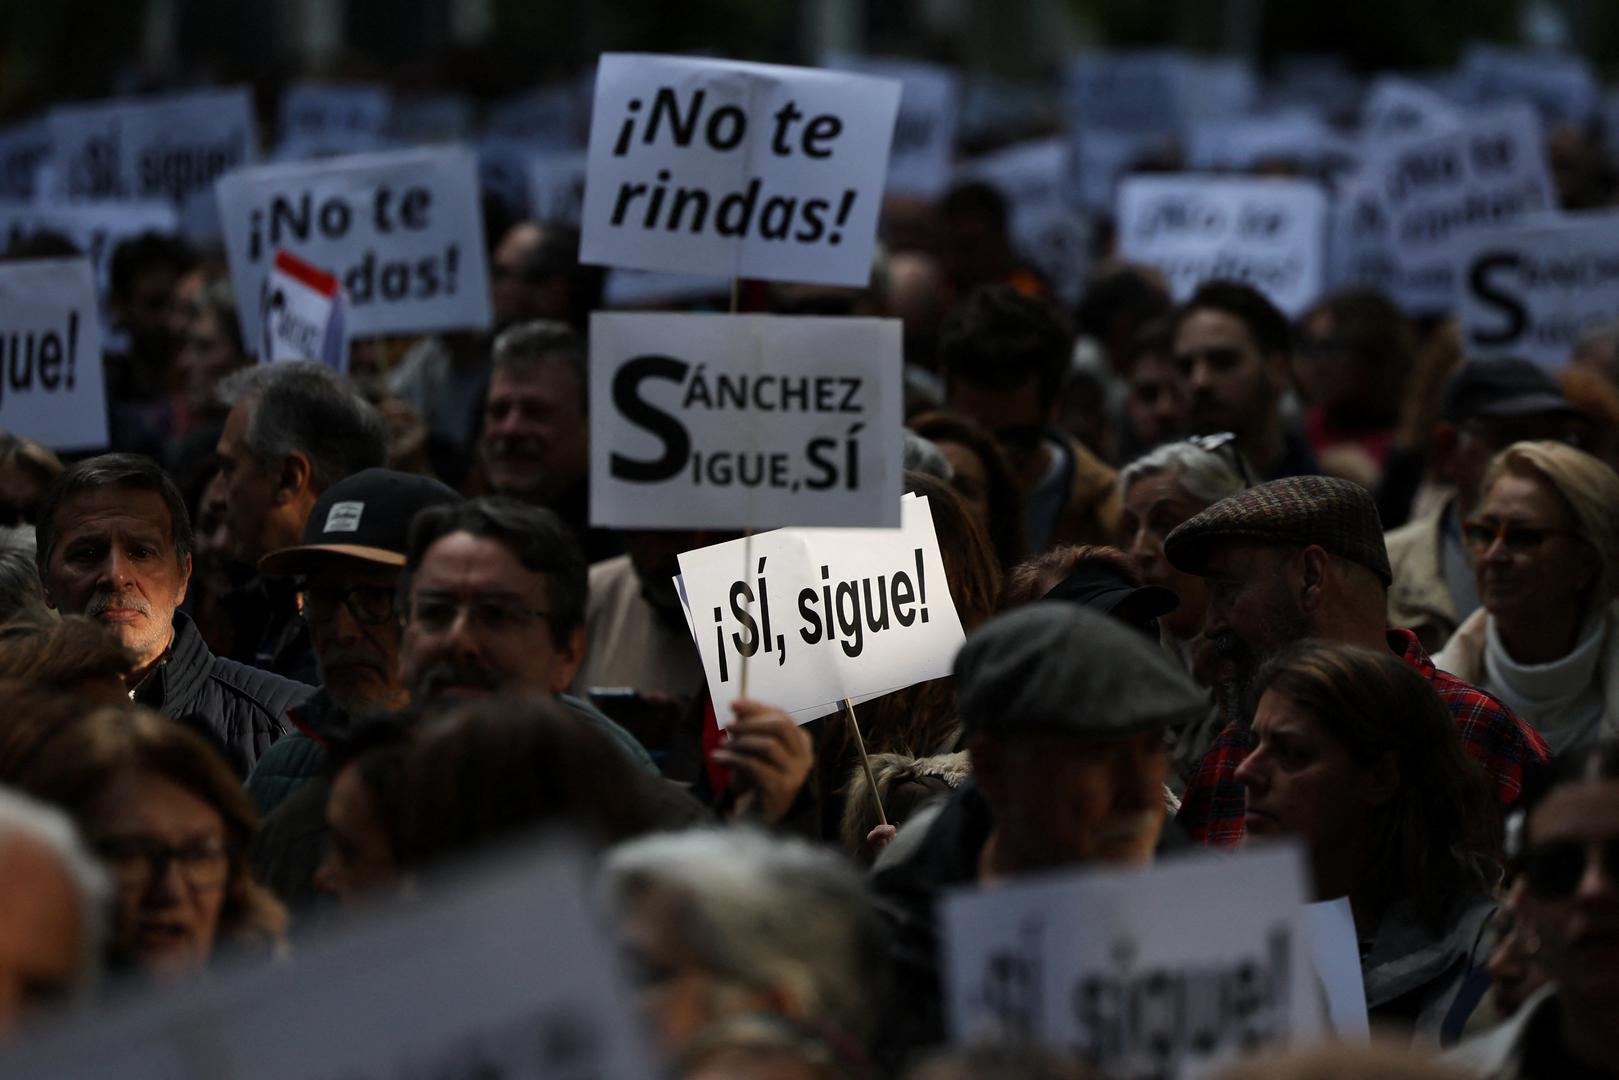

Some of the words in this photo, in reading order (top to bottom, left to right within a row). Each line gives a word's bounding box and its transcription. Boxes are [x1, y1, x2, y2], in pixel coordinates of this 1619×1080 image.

[612, 86, 750, 159] ¡No
[770, 100, 843, 161] te
[247, 190, 352, 262] ¡No
[371, 184, 434, 234] te
[610, 167, 858, 247] rindas!
[0, 310, 80, 410] ue!
[609, 354, 865, 486] SÁNCHEZ
[713, 556, 787, 683] ¡SÍ,
[797, 547, 931, 659] sigue!
